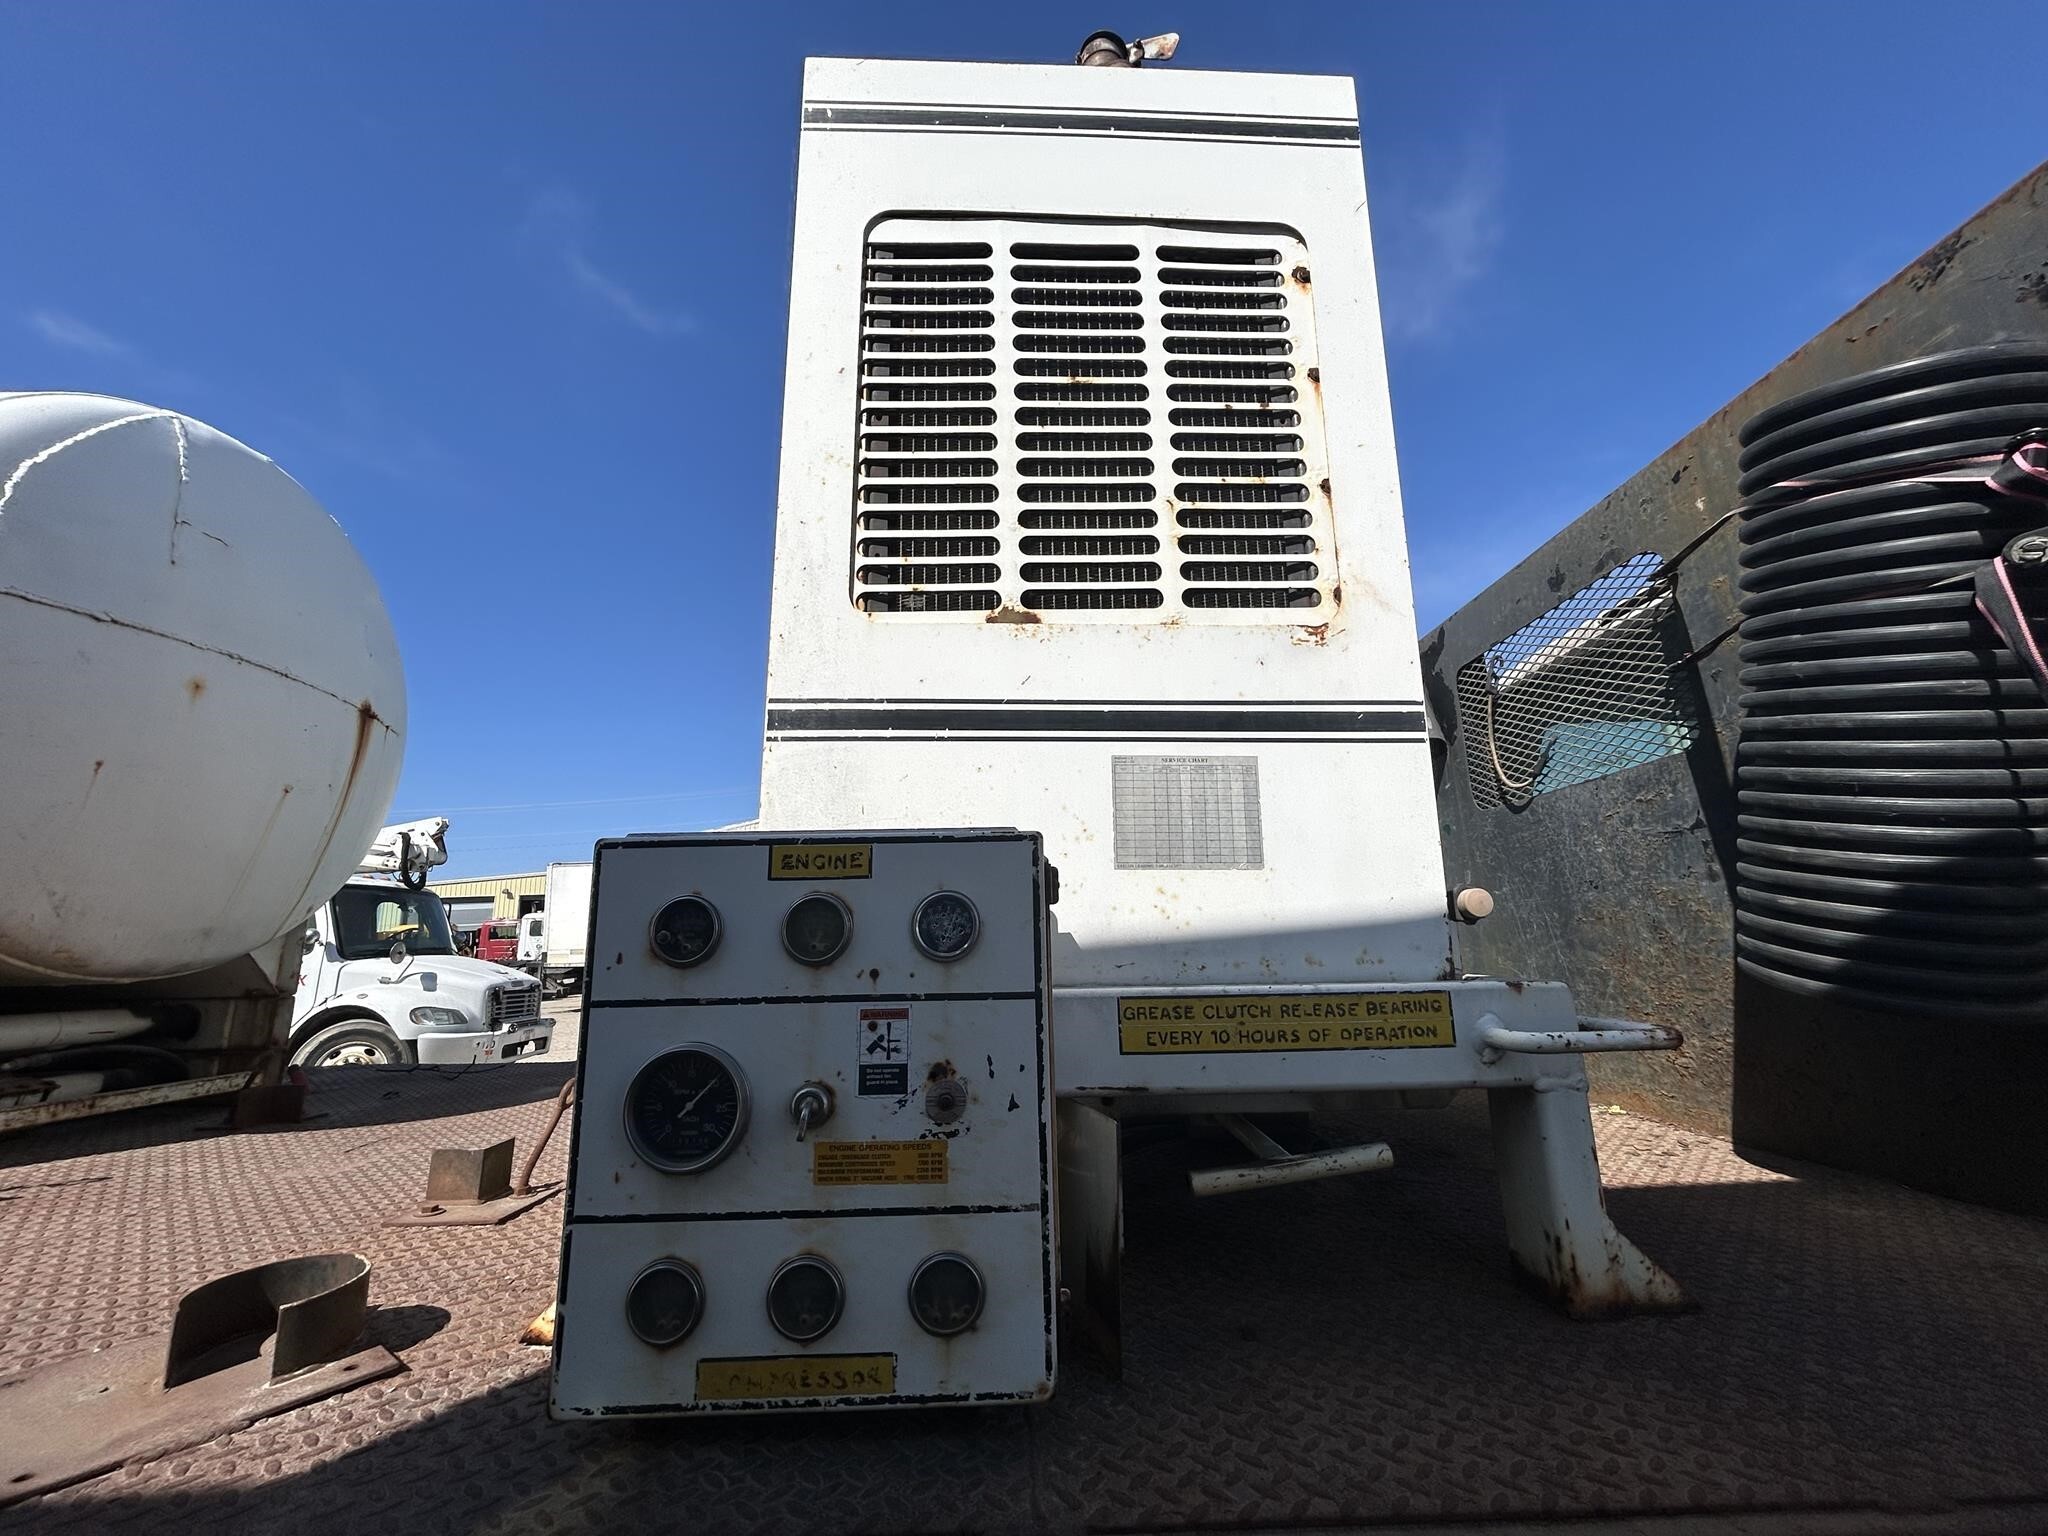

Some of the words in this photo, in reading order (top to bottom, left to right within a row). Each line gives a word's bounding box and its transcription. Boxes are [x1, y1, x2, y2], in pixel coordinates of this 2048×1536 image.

[781, 852, 864, 870] ENGINE
[1123, 1005, 1195, 1020] GREASE
[1202, 1004, 1271, 1019] CLUTCH
[1280, 1002, 1359, 1018] RELEASE
[1366, 999, 1442, 1016] BEARING
[1146, 1030, 1203, 1046] EVERY
[1211, 1029, 1230, 1044] 10
[1239, 1028, 1300, 1044] HOURS
[1308, 1028, 1331, 1042] OF
[1341, 1025, 1438, 1041] OPERATION
[902, 1143, 932, 1151] SPEEDS
